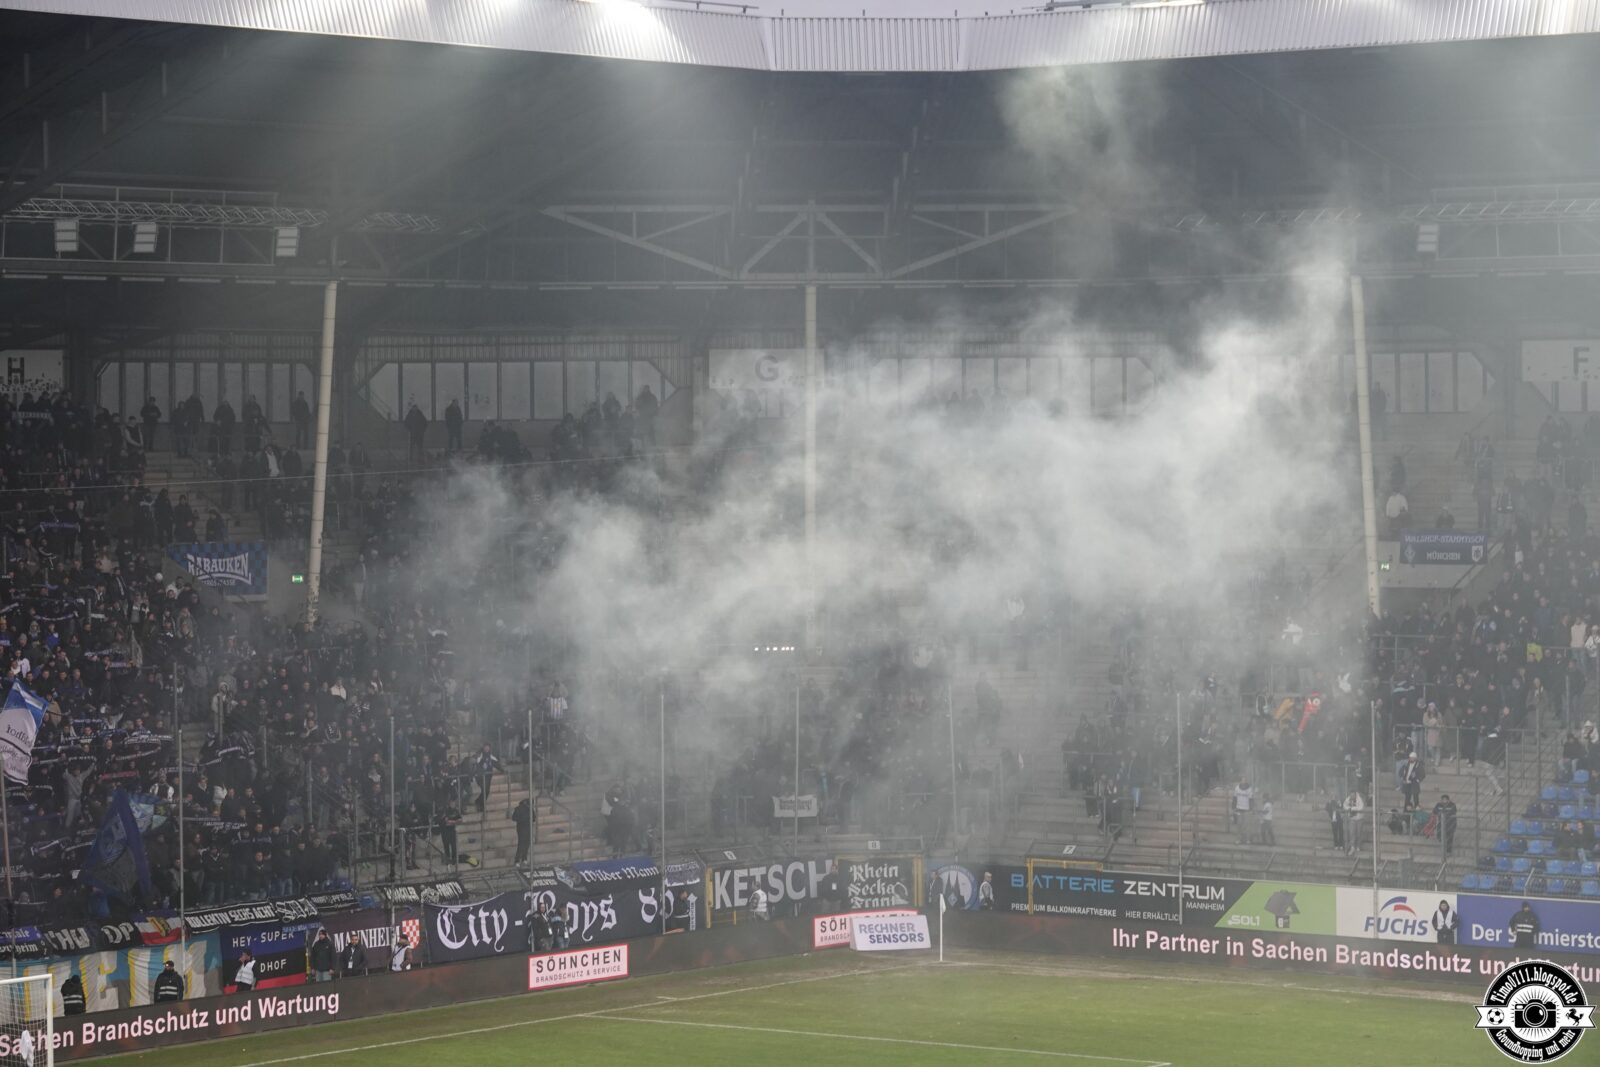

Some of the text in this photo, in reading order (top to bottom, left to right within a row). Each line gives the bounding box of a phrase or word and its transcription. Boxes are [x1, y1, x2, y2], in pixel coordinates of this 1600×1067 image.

[8, 357, 25, 385] H
[755, 355, 780, 381] G
[1573, 346, 1589, 376] F
[184, 552, 249, 578] RABAUKEN
[1426, 550, 1461, 561] MÜNCHEN
[578, 868, 622, 883] Wilder
[621, 865, 660, 880] Mann
[849, 862, 899, 882] Rhein
[714, 859, 833, 910] KETSCH
[1011, 874, 1225, 901] BATTERIE ZENTRUM
[1046, 905, 1117, 918] BALKONKRAFTWERKE
[1125, 910, 1142, 919] HIER
[1142, 911, 1179, 922] ERHÄLTLIC
[1186, 901, 1225, 912] MANNHEIM
[858, 922, 916, 934] RECHNER
[1364, 916, 1429, 936] FUCHS
[1472, 923, 1502, 942] Der
[869, 932, 925, 945] SENSORS
[1112, 927, 1139, 948] Ihr
[1146, 931, 1220, 955] Partner
[1226, 936, 1244, 956] in
[1252, 938, 1328, 963] Sachen
[1335, 943, 1472, 974] Brandschutz
[536, 950, 622, 974] SÖHNCHEN
[535, 965, 621, 983] BRANDSCHUTZ & SERVICE
[82, 1008, 209, 1044] Brandschutz
[215, 1001, 251, 1026] und
[258, 992, 340, 1019] Wartung
